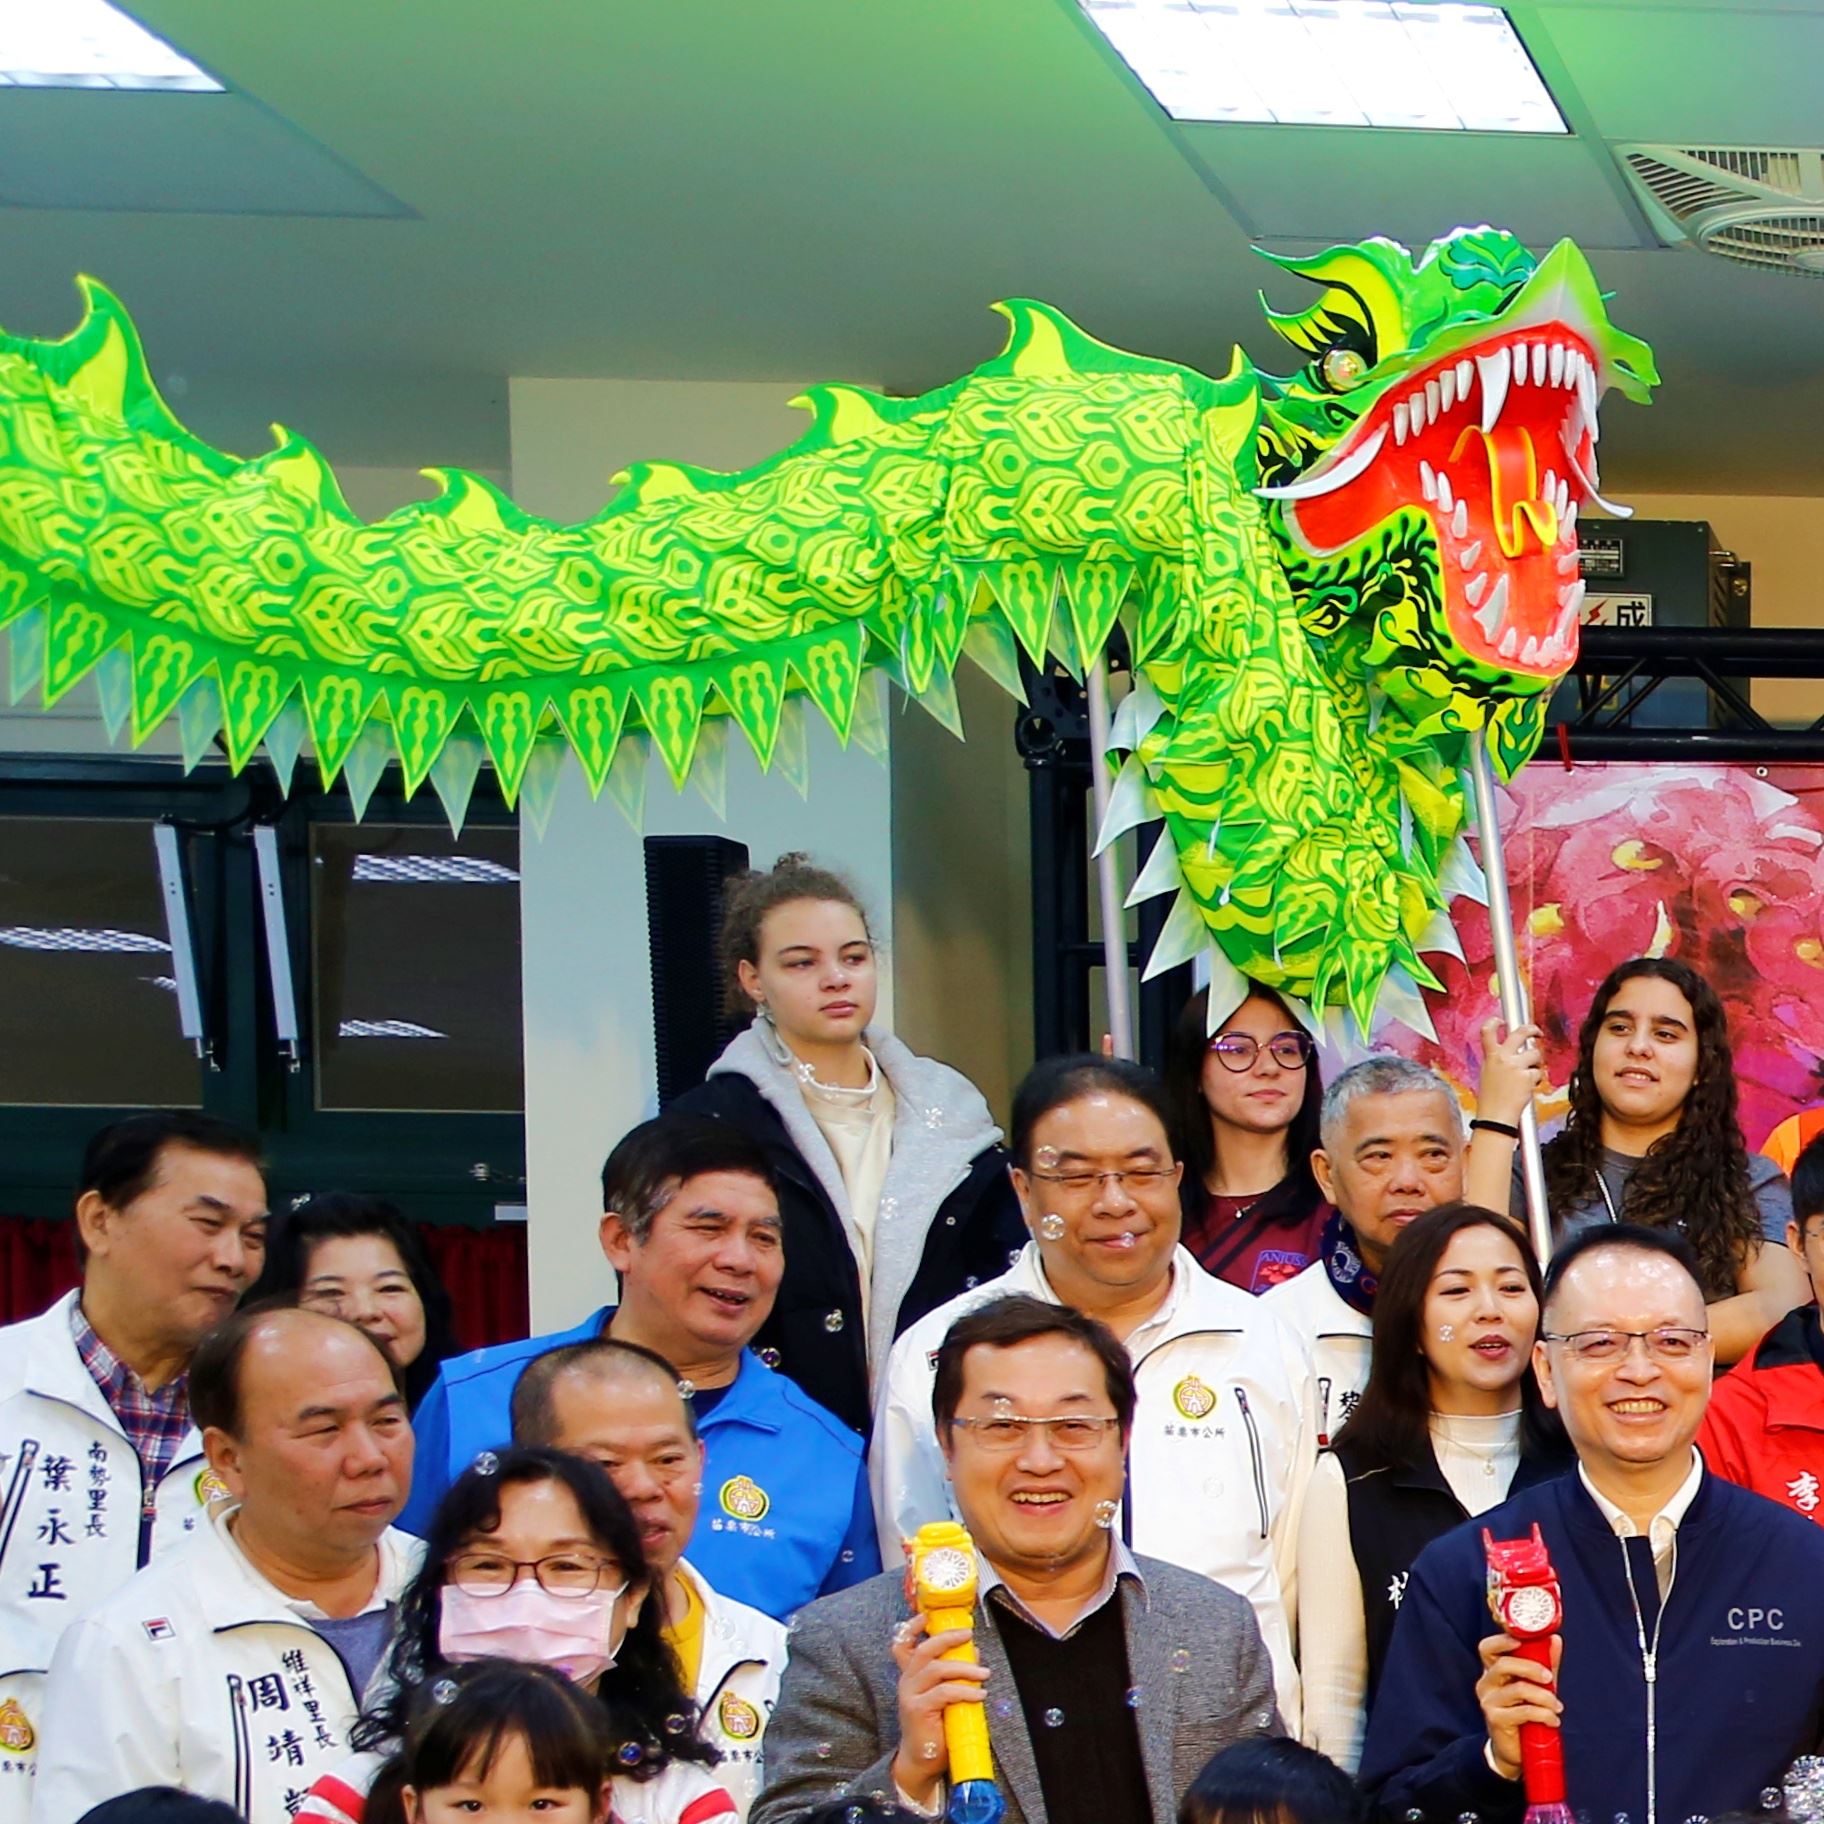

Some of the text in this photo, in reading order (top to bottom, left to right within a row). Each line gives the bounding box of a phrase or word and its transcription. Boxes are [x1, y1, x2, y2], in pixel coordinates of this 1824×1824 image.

[28, 1454, 77, 1600] 葉永正
[1727, 1607, 1785, 1630] CPC
